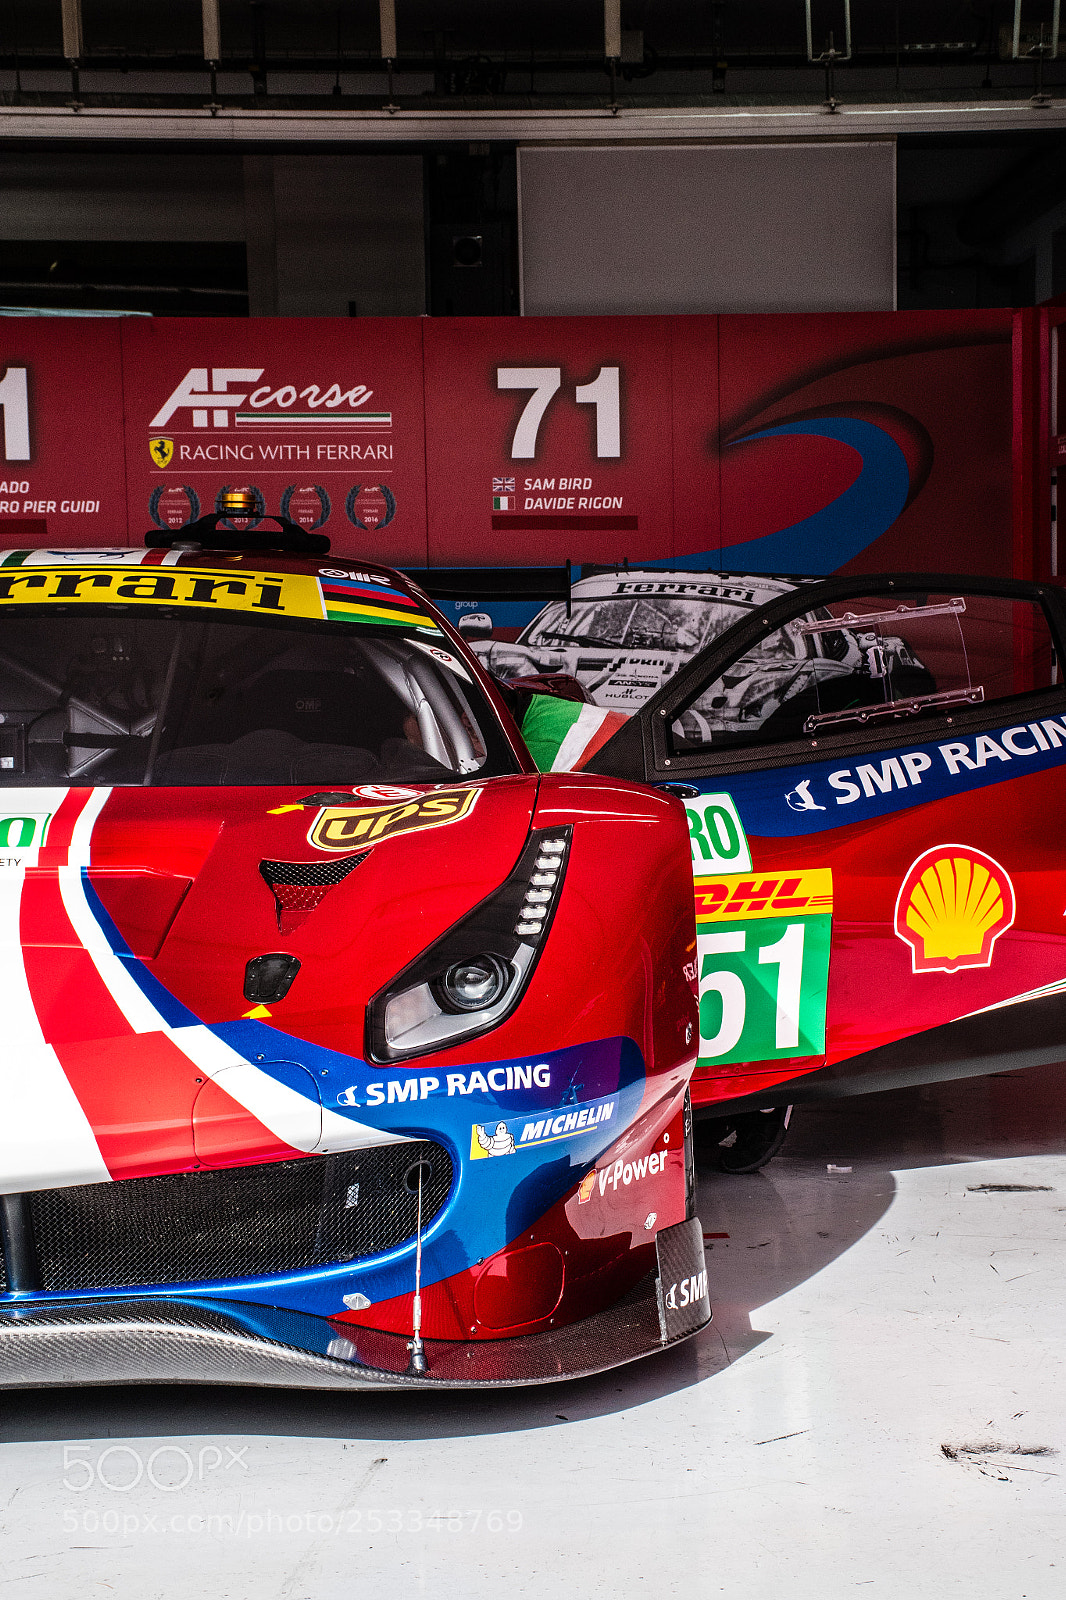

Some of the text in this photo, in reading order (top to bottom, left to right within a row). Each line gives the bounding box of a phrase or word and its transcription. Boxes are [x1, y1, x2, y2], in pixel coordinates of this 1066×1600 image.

[497, 367, 621, 458] 71
[180, 445, 393, 460] RACING WITH FERRARI
[524, 477, 592, 491] SAM BIRD
[23, 500, 56, 513] PIER
[60, 500, 100, 513] GUIDI
[524, 496, 623, 510] DAVIDE RIGON
[455, 601, 479, 610] group
[612, 582, 756, 602] Ferrari
[828, 750, 931, 804] SMP
[697, 923, 805, 1059] 51
[366, 1064, 551, 1105] SMP RACING
[520, 1102, 614, 1142] MICHELIN
[599, 1149, 668, 1197] V-Power
